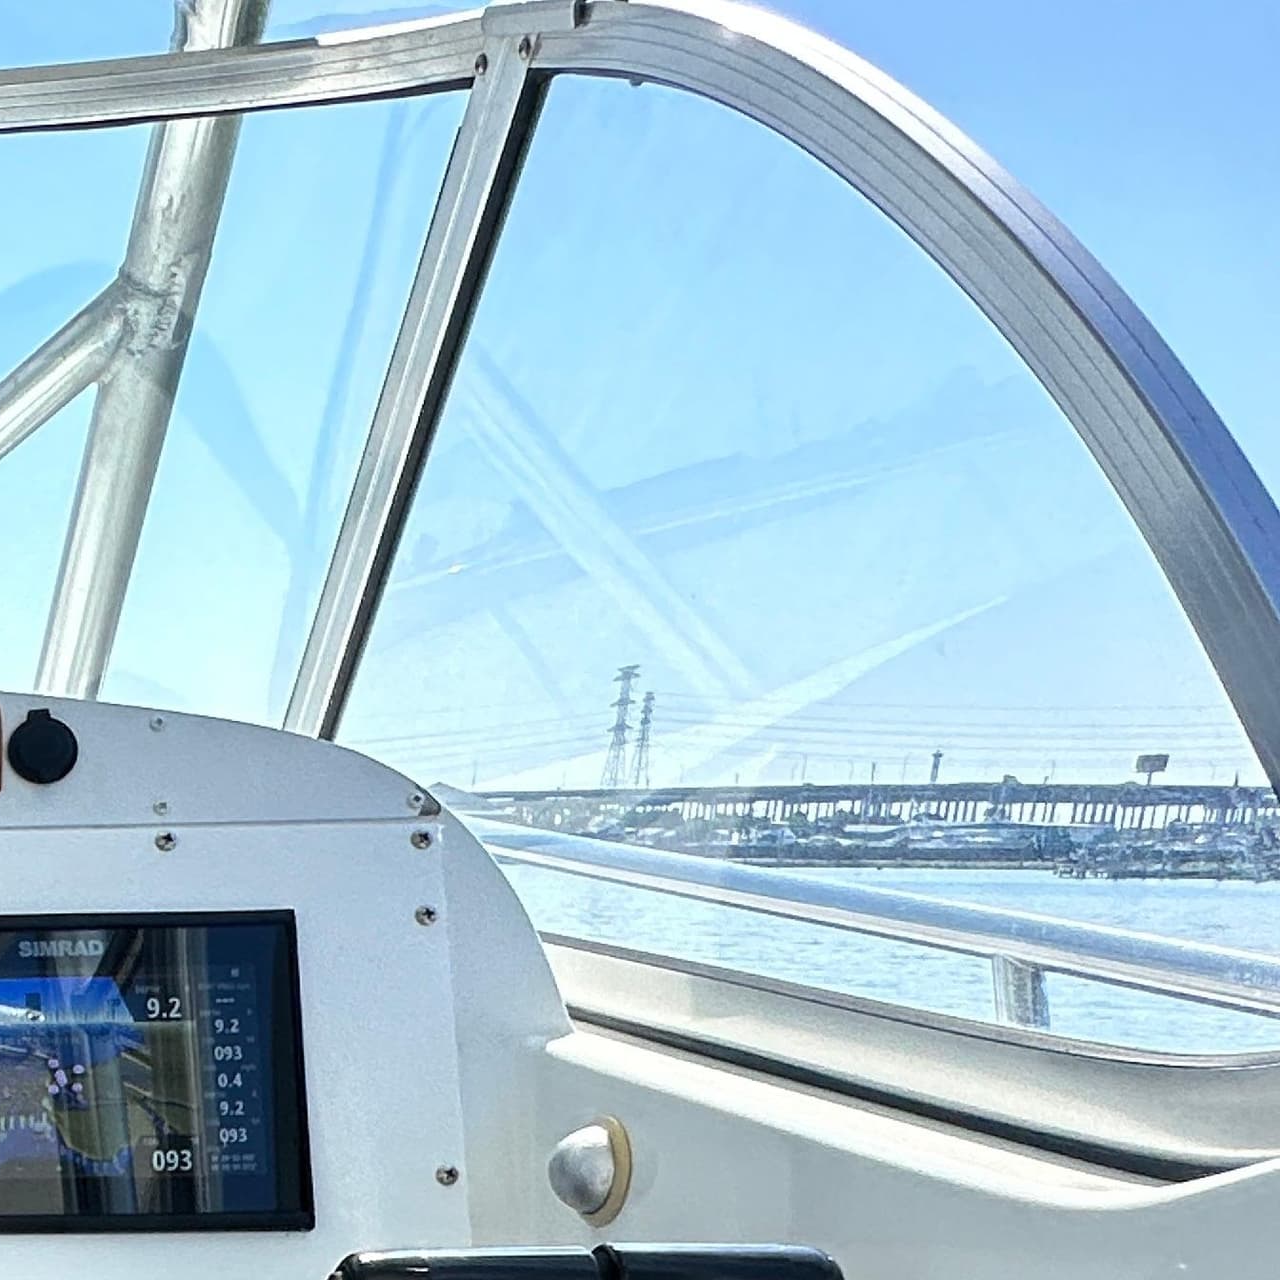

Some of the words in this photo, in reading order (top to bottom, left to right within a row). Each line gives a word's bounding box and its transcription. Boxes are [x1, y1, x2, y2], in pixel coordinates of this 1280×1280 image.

[18, 940, 105, 957] SIMRAD
[146, 997, 182, 1019] 9.2
[214, 1019, 240, 1033] 9.2
[214, 1046, 242, 1060] 093
[217, 1073, 242, 1088] 0.4
[219, 1101, 245, 1115] 9.2
[219, 1128, 247, 1143] 093
[152, 1149, 193, 1171] 093
